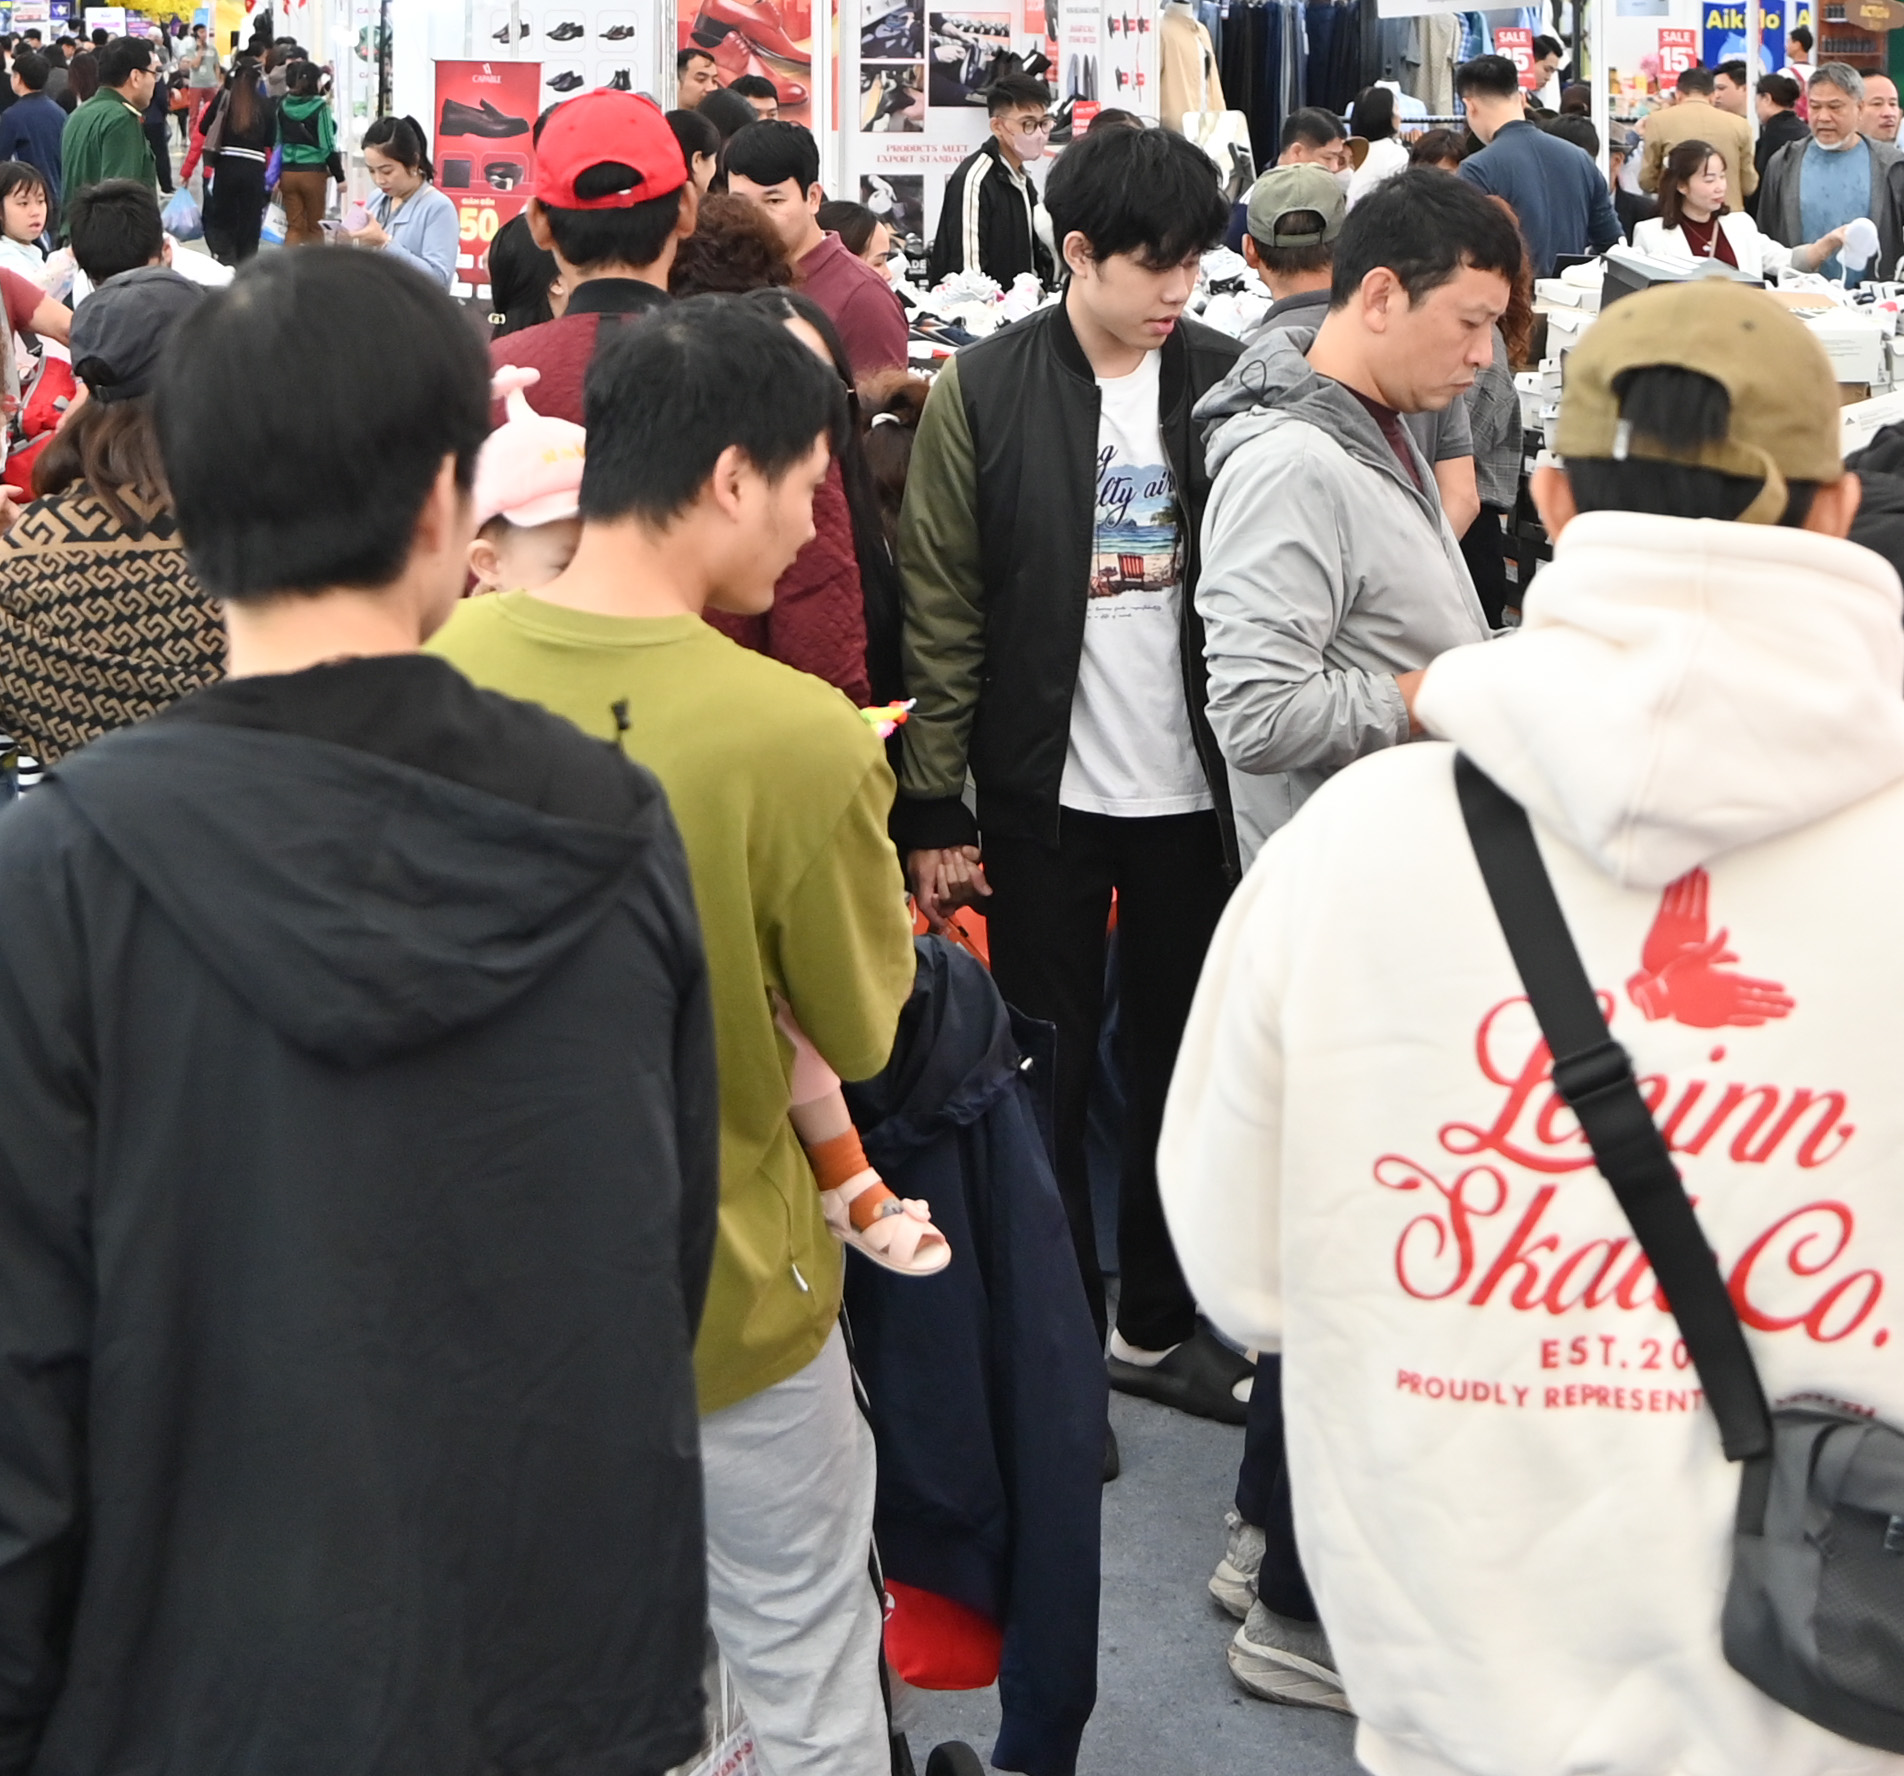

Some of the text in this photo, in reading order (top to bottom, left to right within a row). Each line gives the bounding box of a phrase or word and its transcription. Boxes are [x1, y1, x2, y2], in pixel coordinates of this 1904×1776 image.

[1498, 31, 1527, 44] SALE
[1662, 31, 1690, 44] SALE
[886, 144, 969, 154] PRODUCTS MEET
[1541, 1336, 1628, 1371] EST.
[1396, 1370, 1531, 1408] PROUDLY
